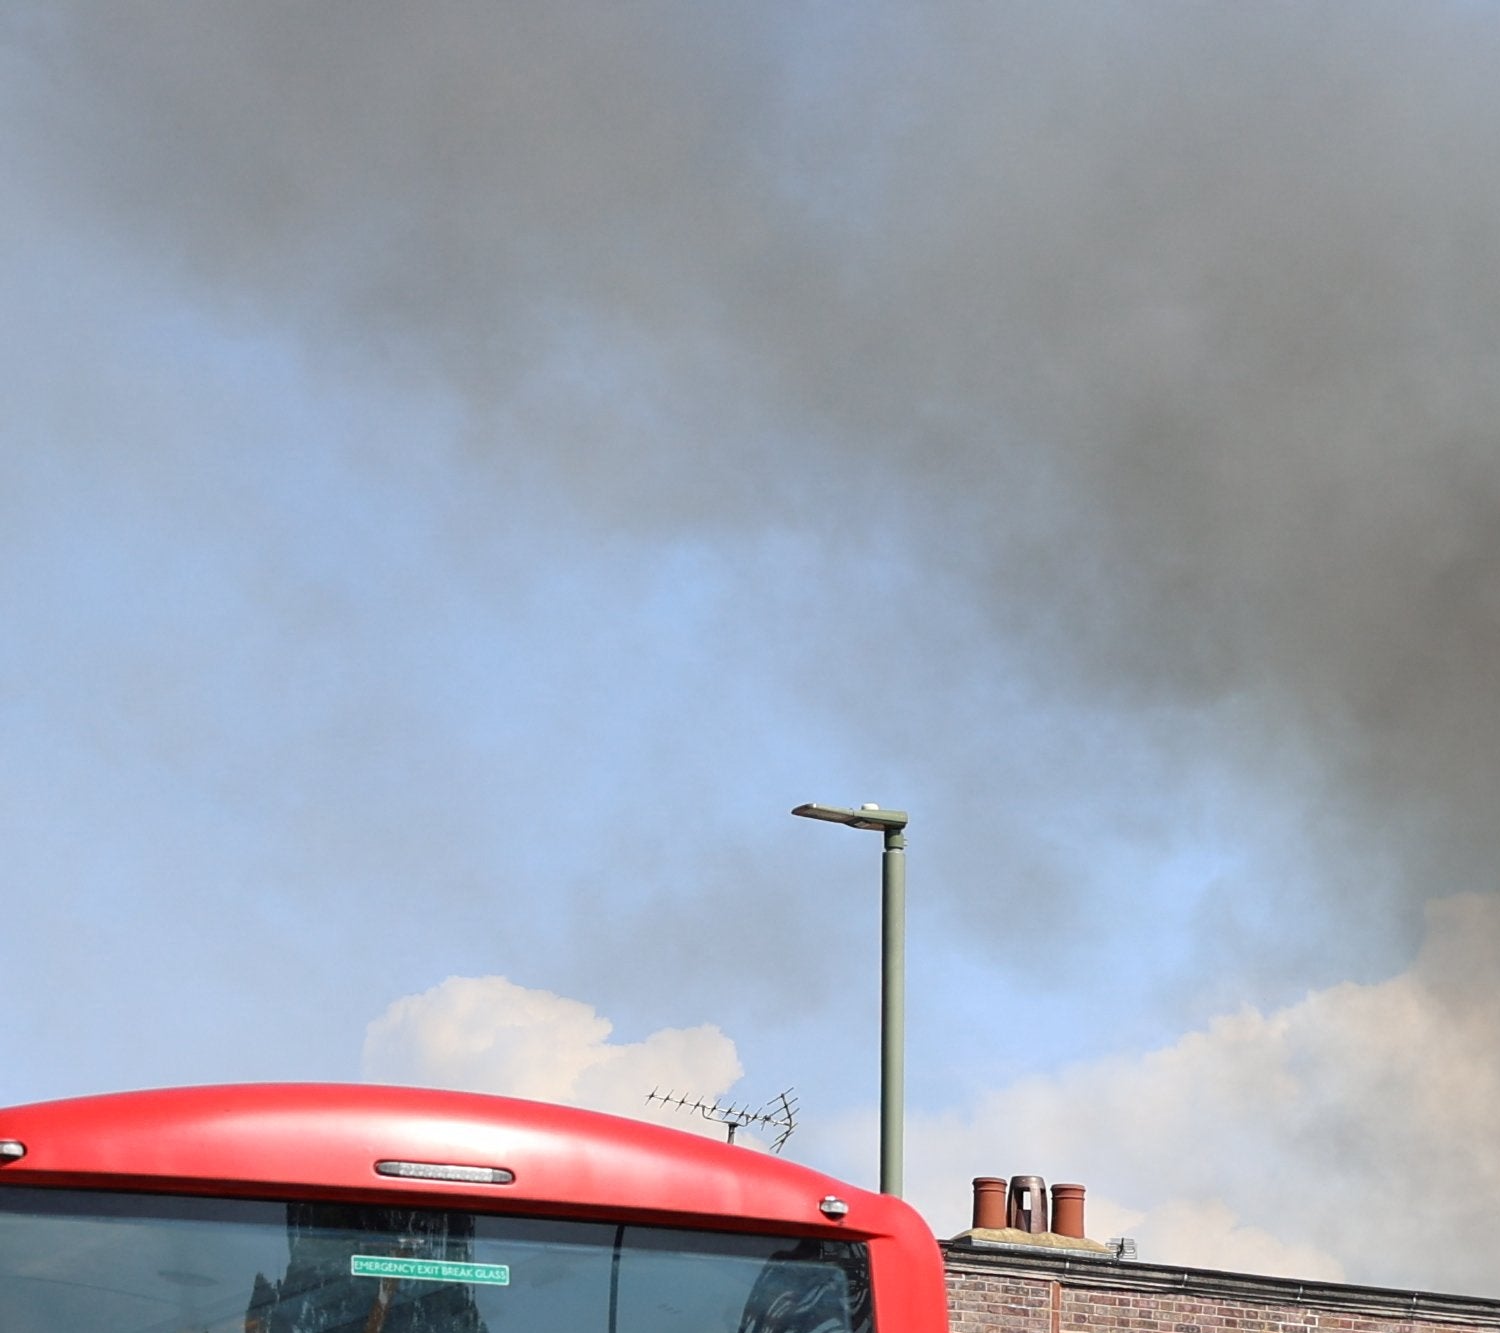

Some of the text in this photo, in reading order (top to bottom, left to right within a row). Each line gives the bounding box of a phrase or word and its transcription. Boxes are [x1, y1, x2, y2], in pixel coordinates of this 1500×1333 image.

[354, 1261, 506, 1280] EMERGENCY EXIT BREAK GLASS
